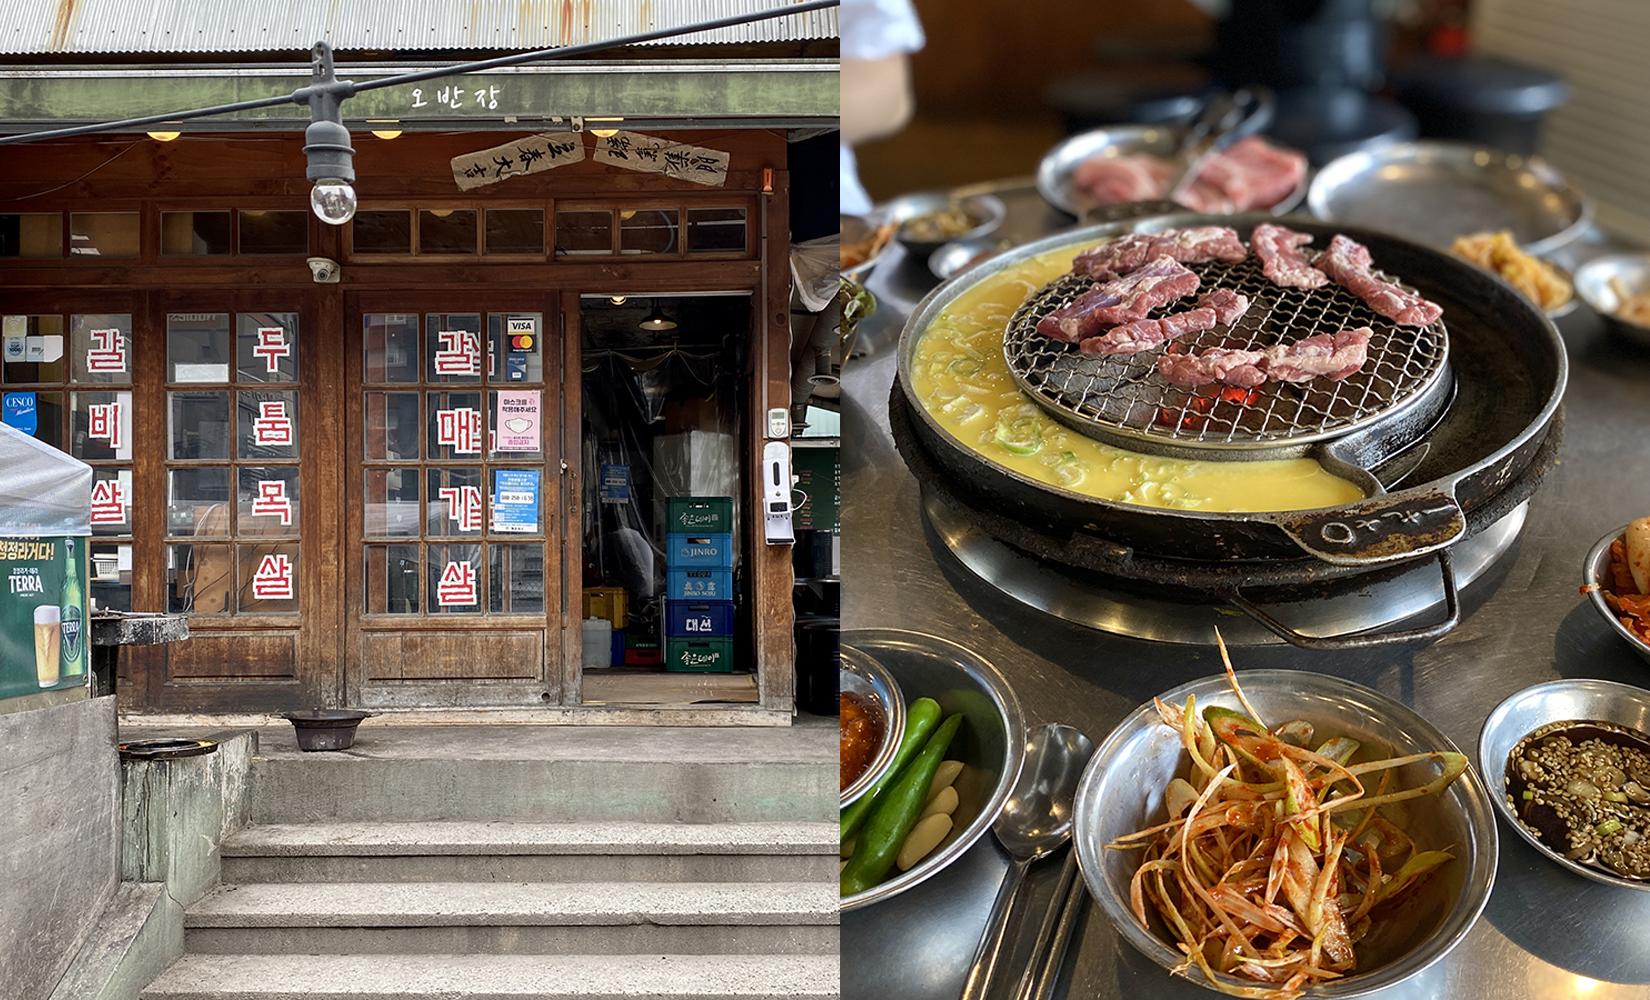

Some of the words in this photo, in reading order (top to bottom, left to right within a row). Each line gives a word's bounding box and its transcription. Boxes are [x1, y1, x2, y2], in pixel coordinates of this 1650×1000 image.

[511, 322, 531, 330] VISA
[6, 397, 33, 407] CESCO
[690, 548, 717, 557] JINRO
[8, 575, 44, 593] TERRA
[62, 621, 80, 634] TERRA
[686, 617, 712, 631] 대선
